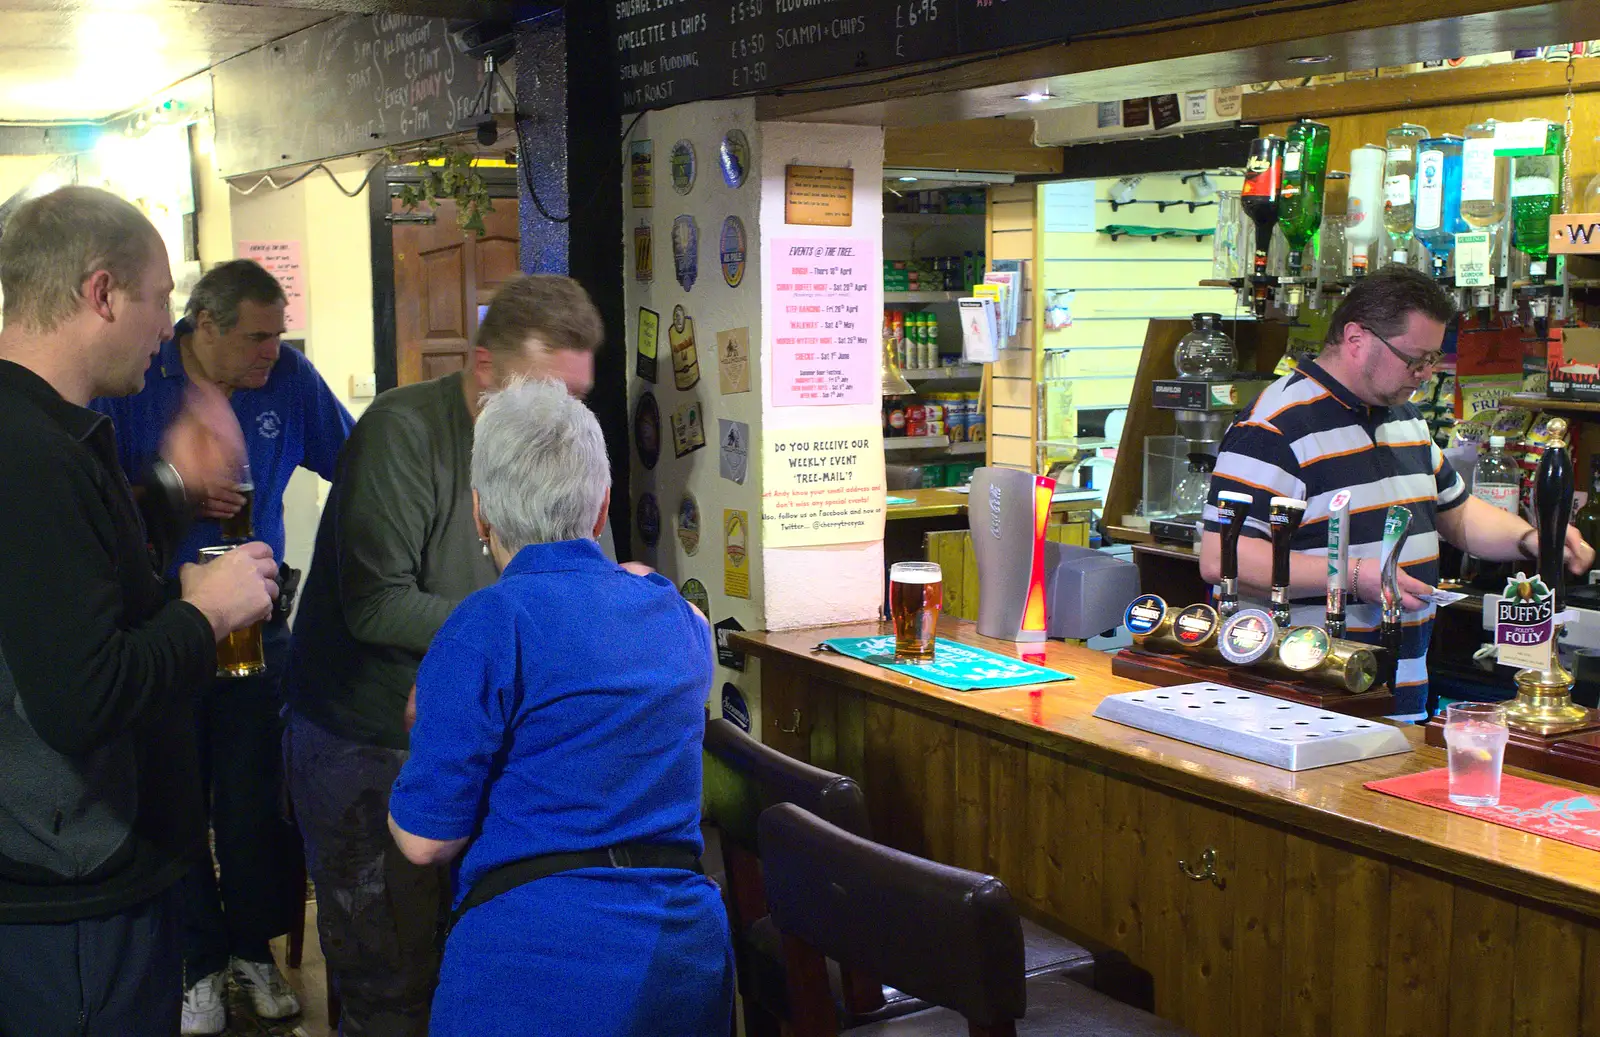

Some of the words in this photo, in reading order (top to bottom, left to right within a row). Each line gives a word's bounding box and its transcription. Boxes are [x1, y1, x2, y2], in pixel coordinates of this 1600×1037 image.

[617, 23, 666, 51] OMELETTE
[680, 13, 707, 35] CHIPS
[831, 16, 866, 39] CHIPS
[659, 51, 700, 74] PUDDING
[644, 80, 675, 103] ROAST
[789, 246, 814, 256] EVENTS
[815, 246, 824, 257] @
[824, 246, 838, 256] THE
[854, 283, 868, 292] April
[846, 305, 859, 314] April
[844, 321, 855, 330] May
[1472, 388, 1511, 399] SCAMPI
[1471, 399, 1499, 413] FRI
[775, 443, 786, 452] DO
[790, 442, 810, 452] YOU
[813, 440, 848, 451] RECEIVE
[852, 439, 869, 449] OUR
[788, 457, 827, 468] WEEKLY
[830, 455, 857, 466] EVENT
[774, 490, 790, 498] Andy
[810, 489, 825, 498] your
[776, 500, 794, 508] don't
[812, 500, 823, 508] any
[825, 498, 846, 507] special
[778, 512, 798, 520] follow
[819, 509, 848, 517] Facebook
[850, 508, 861, 516] and
[1505, 631, 1544, 644] FOLLY
